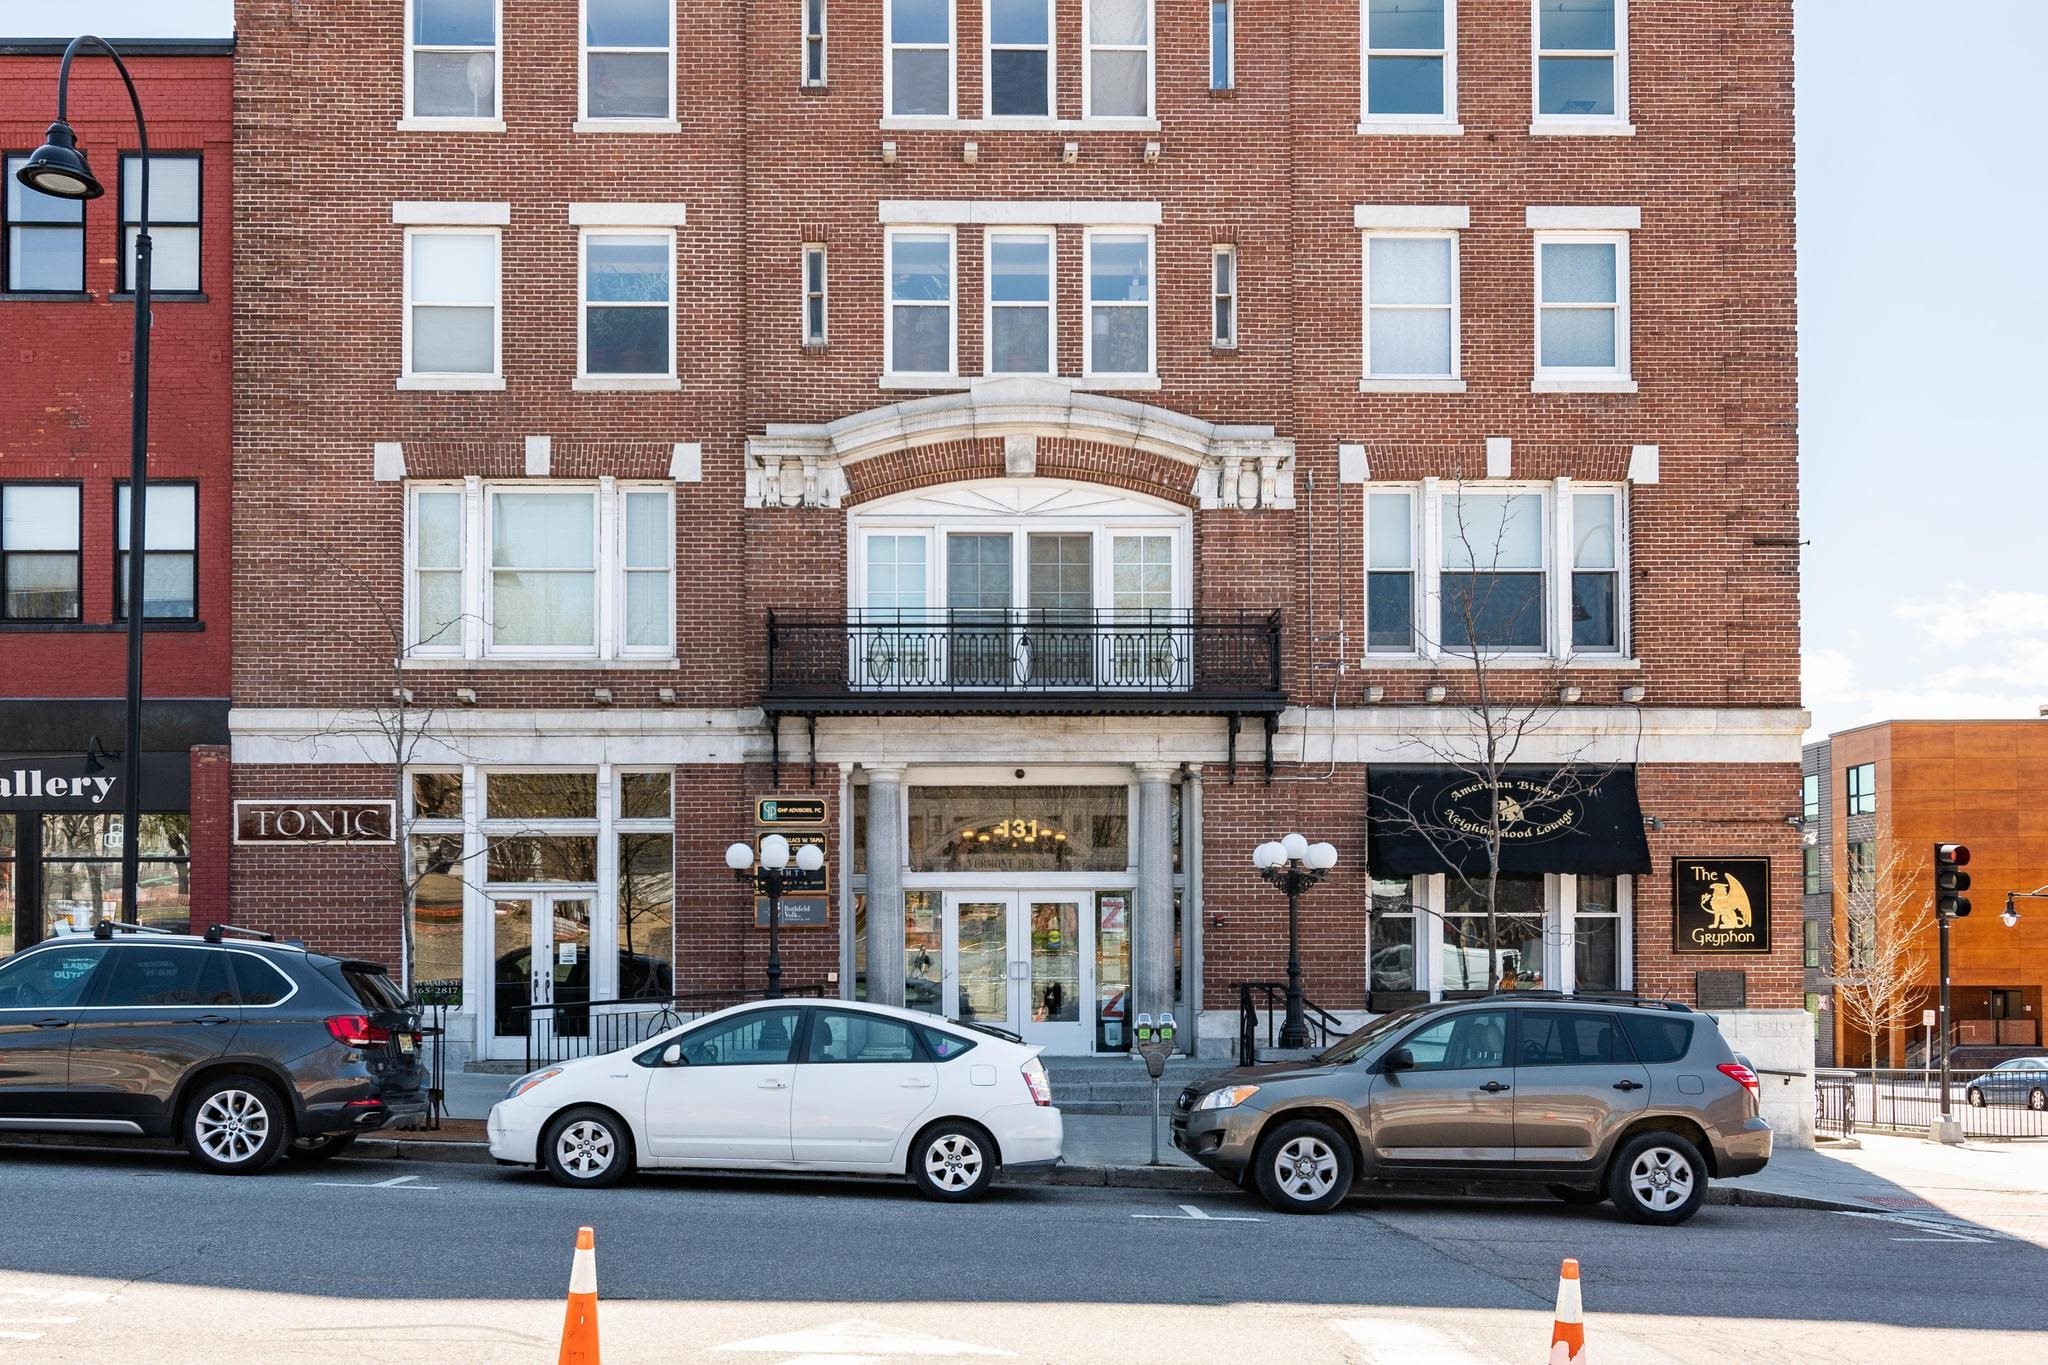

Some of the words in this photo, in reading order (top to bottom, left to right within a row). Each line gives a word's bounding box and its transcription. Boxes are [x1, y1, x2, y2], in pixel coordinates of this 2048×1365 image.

[0, 769, 117, 804] allery
[1517, 780, 1561, 801] Bistro
[250, 809, 379, 837] TONIC
[1000, 819, 1037, 838] 131
[1535, 807, 1575, 836] Lounge
[968, 858, 1013, 869] VERMONT
[1018, 858, 1050, 869] HOUSE
[1690, 866, 1718, 881] The
[1692, 928, 1755, 946] Gryphon
